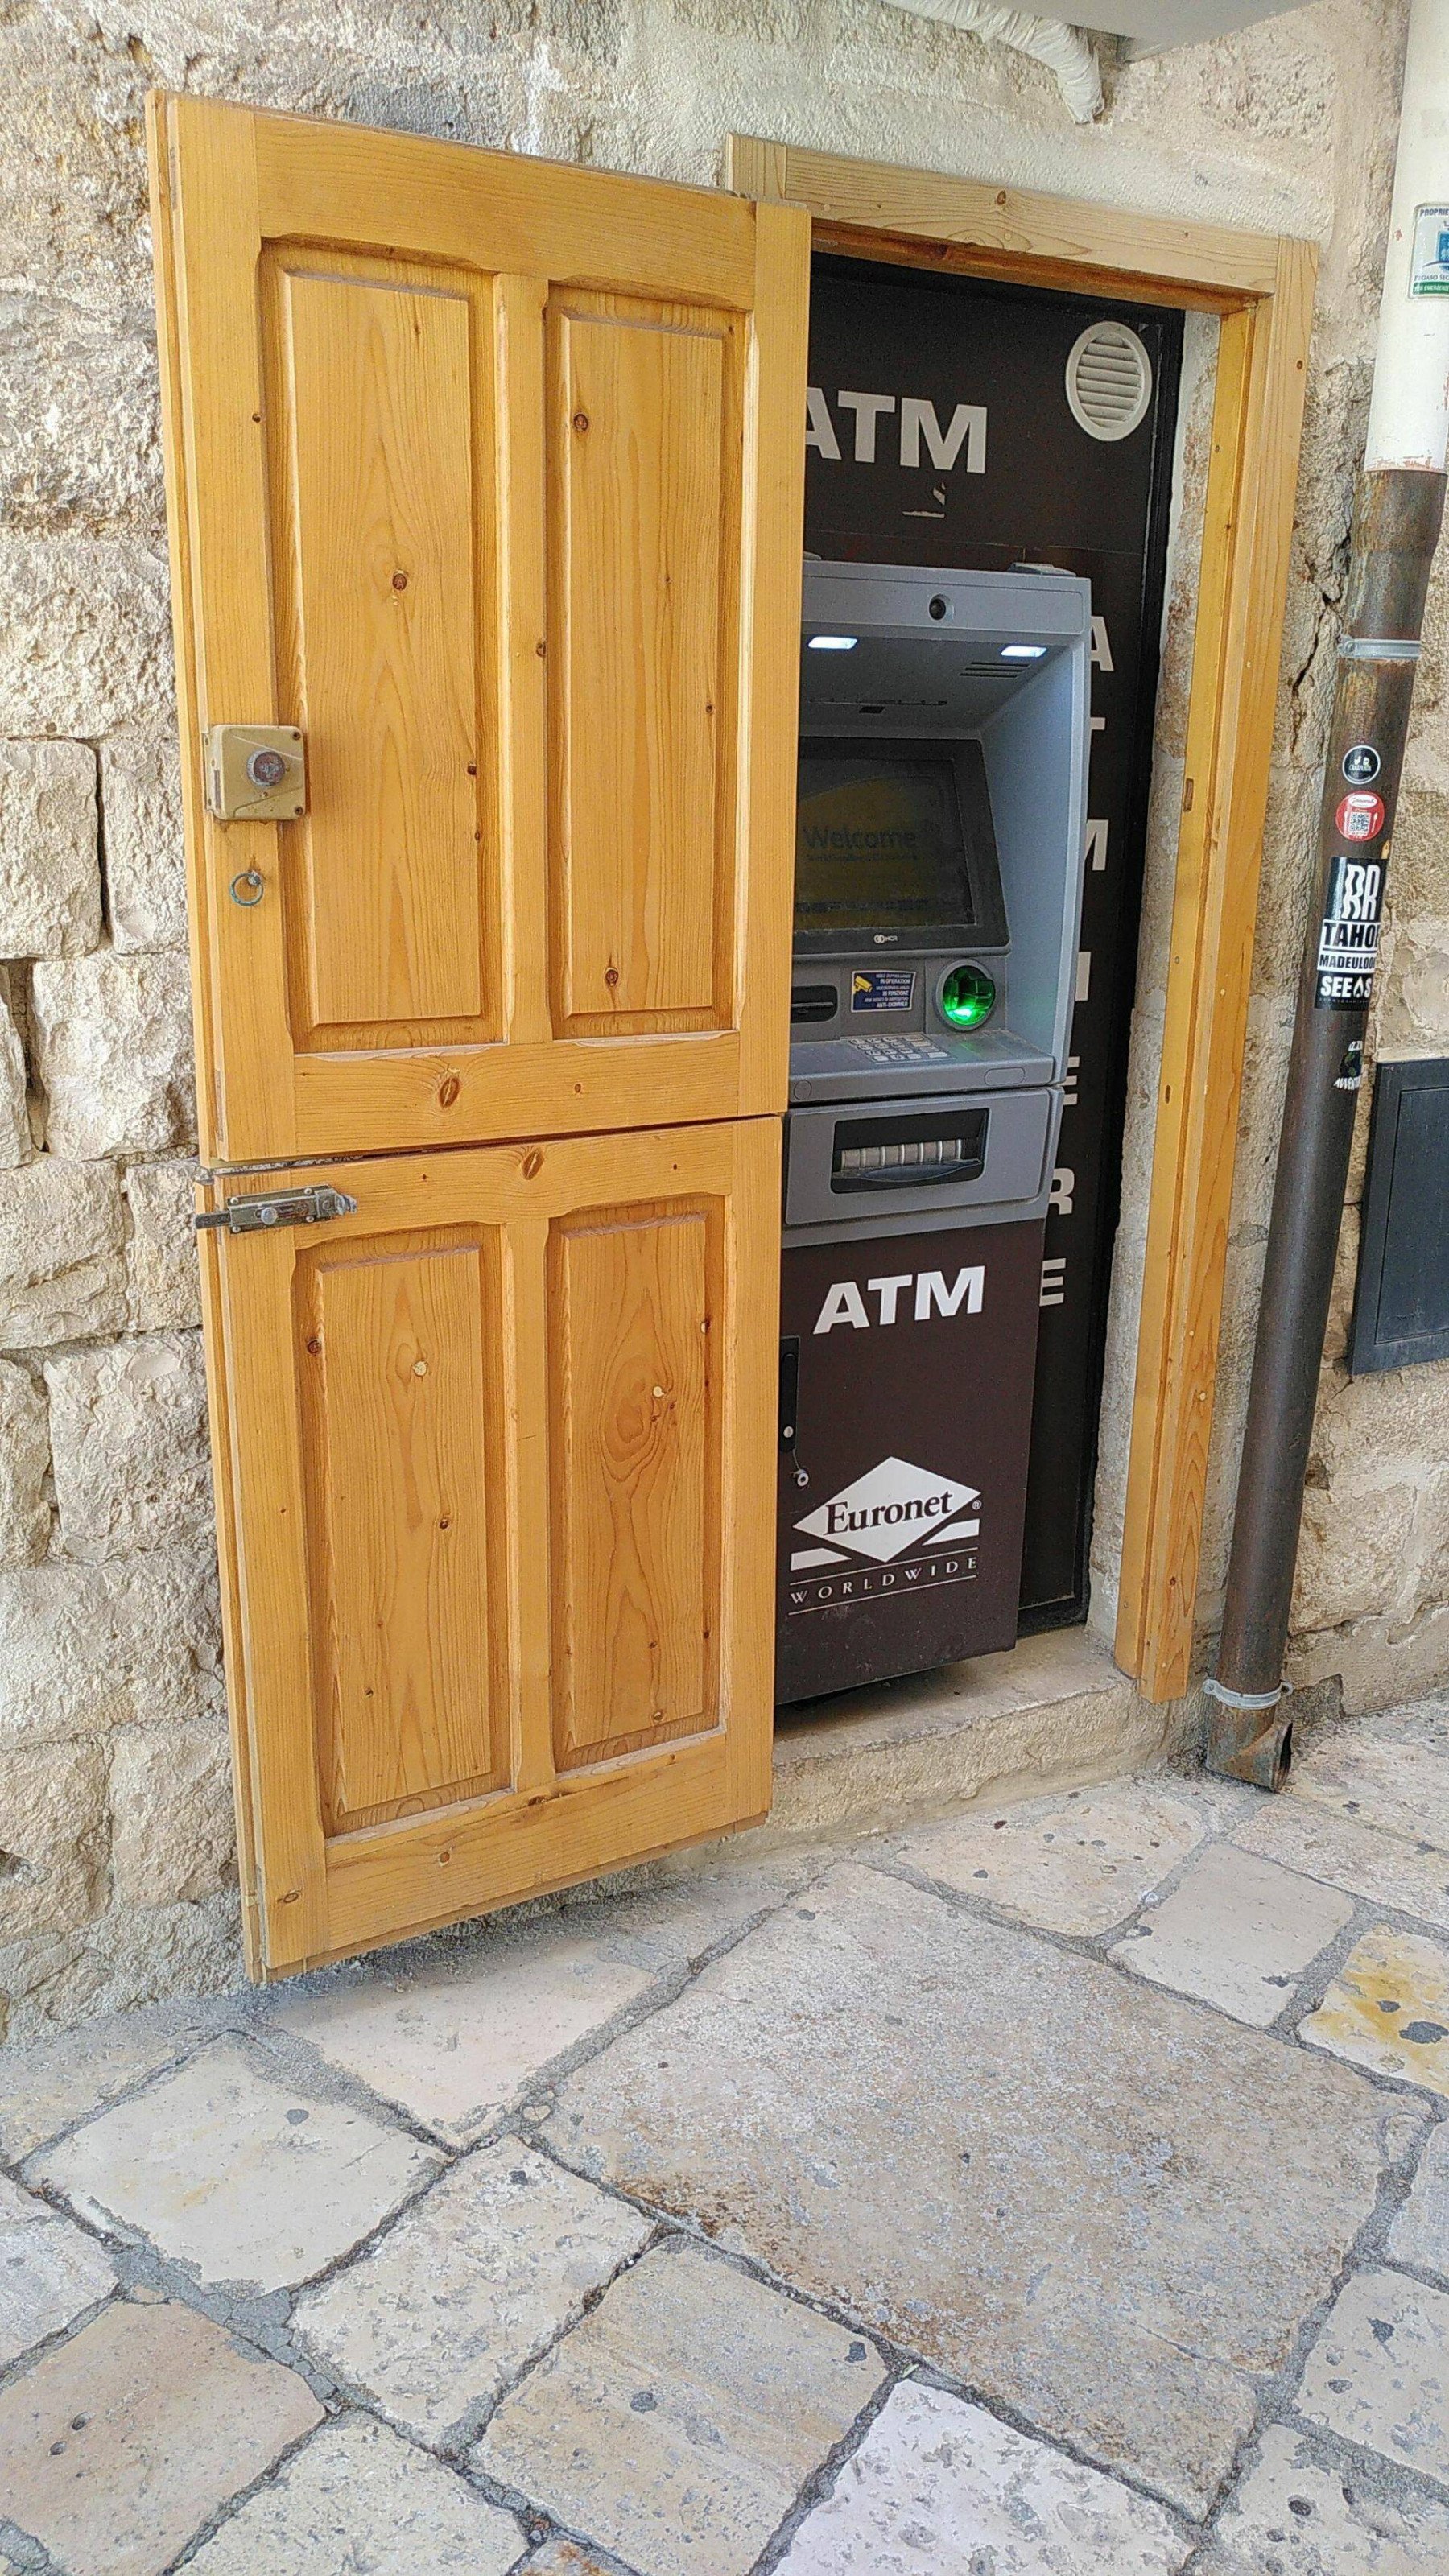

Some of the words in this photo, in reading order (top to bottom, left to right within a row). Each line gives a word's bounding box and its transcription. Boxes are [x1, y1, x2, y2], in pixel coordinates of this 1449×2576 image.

[803, 824, 916, 849] Welcome
[812, 1265, 985, 1335] ATM
[823, 1491, 953, 1536] Euronet
[790, 1557, 977, 1604] WORLDWIDE
